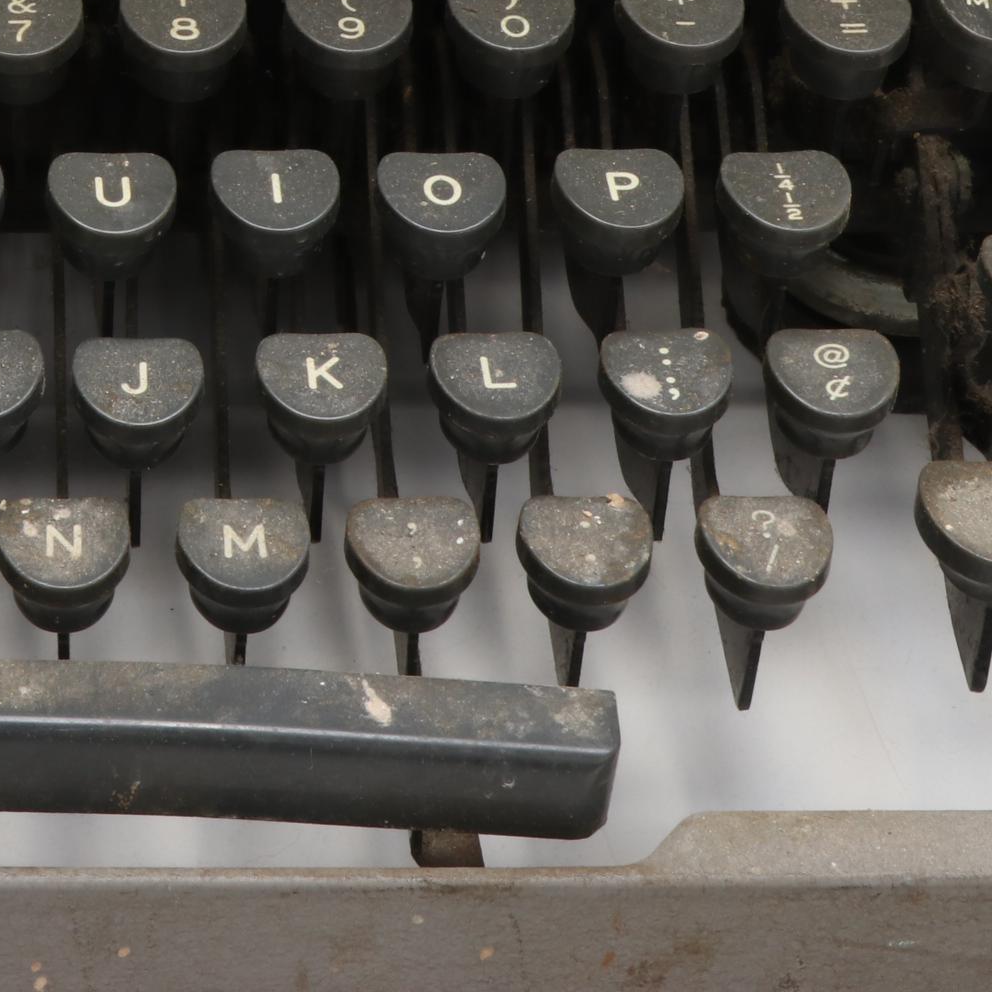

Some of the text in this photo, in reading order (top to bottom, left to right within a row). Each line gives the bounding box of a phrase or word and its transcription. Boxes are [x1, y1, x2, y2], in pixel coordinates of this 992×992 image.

[8, 20, 33, 42] 7
[170, 18, 199, 40] 8
[337, 17, 365, 39] 9
[95, 176, 131, 207] U
[271, 173, 282, 204] I
[423, 175, 462, 206] O
[605, 171, 640, 201] P
[813, 344, 850, 367] @
[122, 362, 148, 395] J
[305, 357, 343, 390] K
[480, 356, 517, 389] L
[751, 510, 775, 539] ?
[45, 524, 83, 557] N
[223, 524, 268, 558] M
